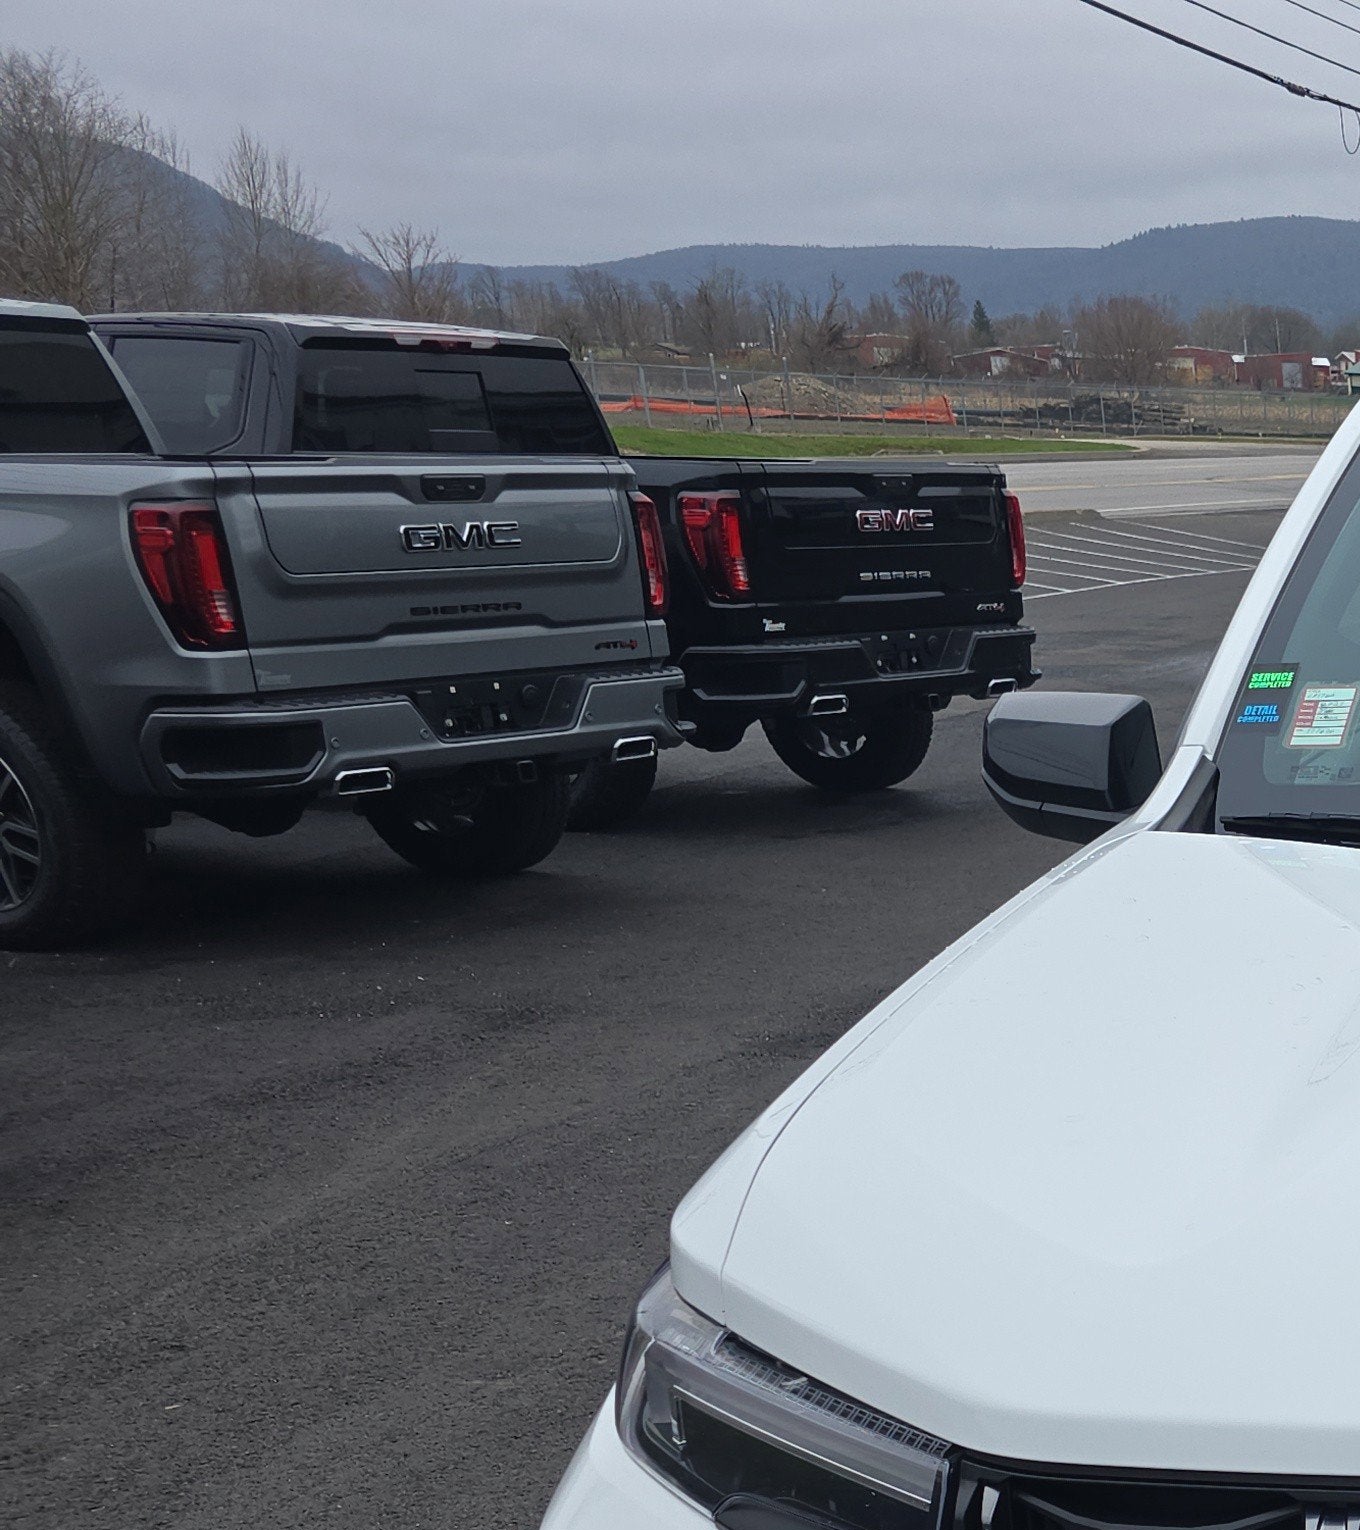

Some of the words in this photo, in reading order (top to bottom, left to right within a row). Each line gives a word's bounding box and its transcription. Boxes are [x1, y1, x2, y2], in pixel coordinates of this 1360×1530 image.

[856, 508, 934, 533] GMC
[400, 521, 522, 553] GMC
[860, 570, 932, 581] SIERRA
[410, 601, 523, 617] SIERRA
[1251, 672, 1295, 682] SERVICE
[1244, 704, 1279, 716] DETAIL
[1236, 715, 1280, 724] COMPLETED
